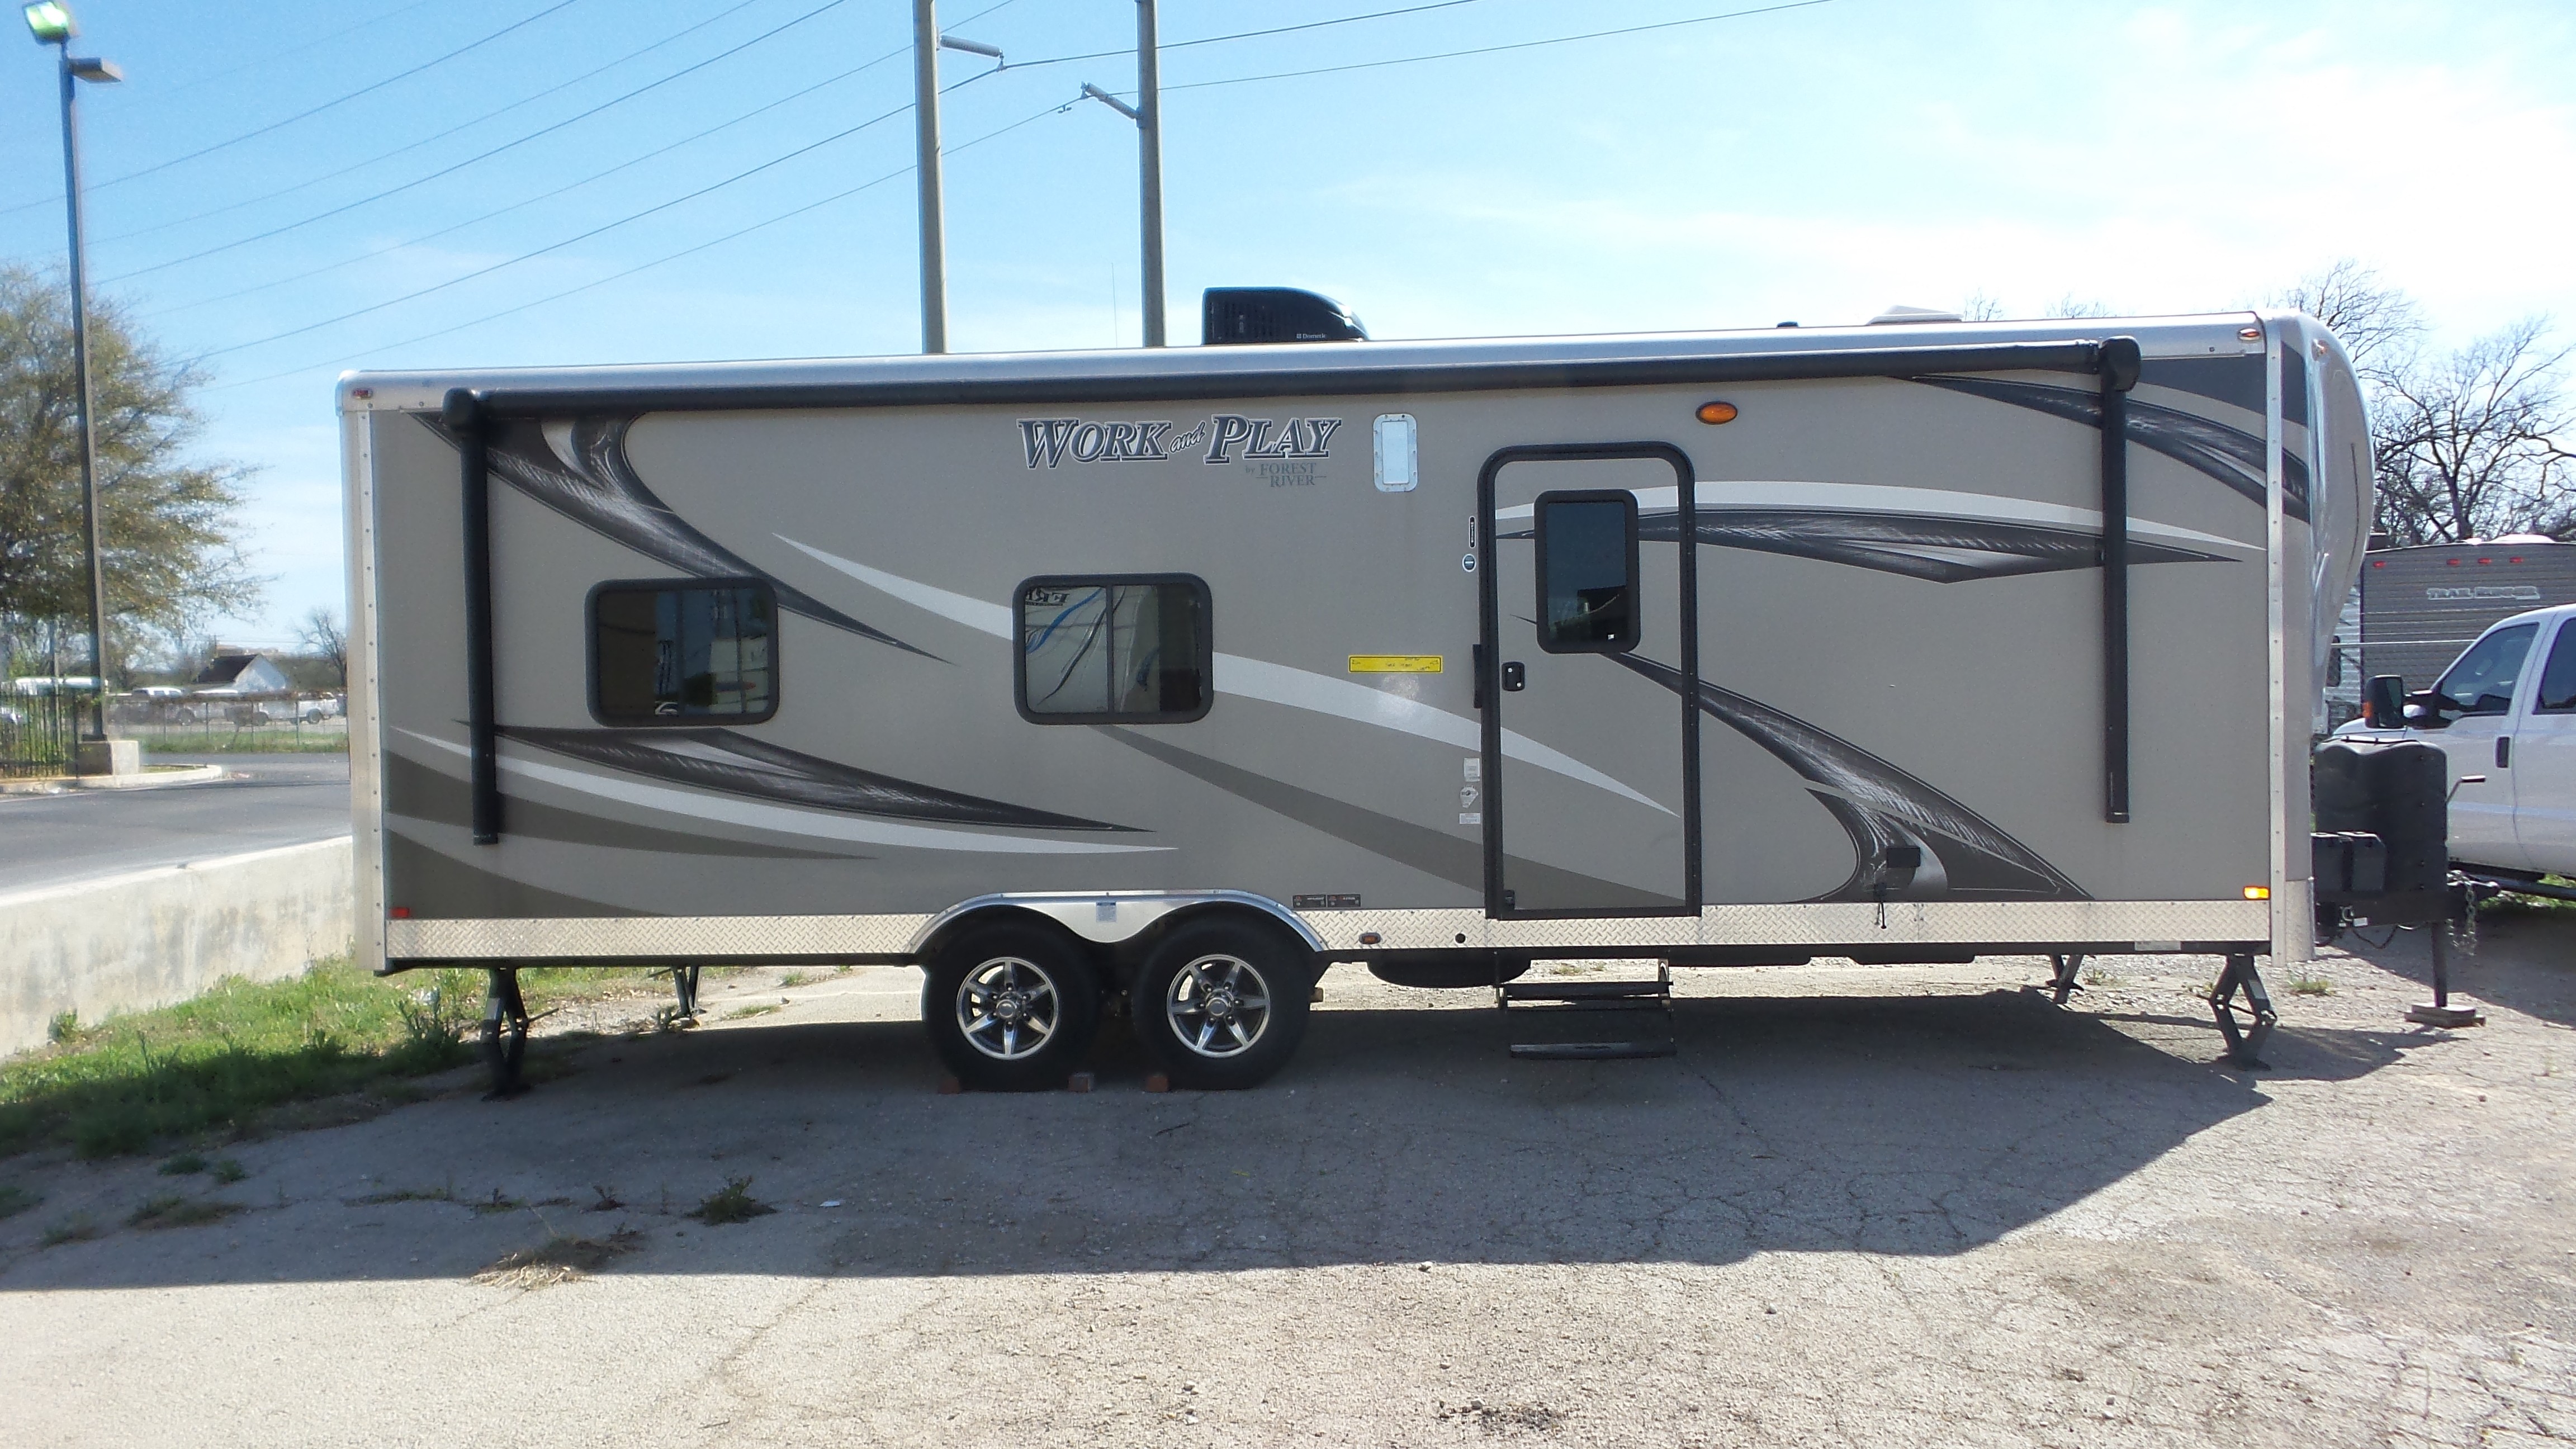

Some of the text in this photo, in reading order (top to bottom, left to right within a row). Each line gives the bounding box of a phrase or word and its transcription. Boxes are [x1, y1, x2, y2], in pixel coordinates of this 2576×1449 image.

[1016, 414, 1342, 470] WORK and PLAY
[1245, 462, 1317, 475] by FOREST
[1270, 475, 1315, 487] RIVER
